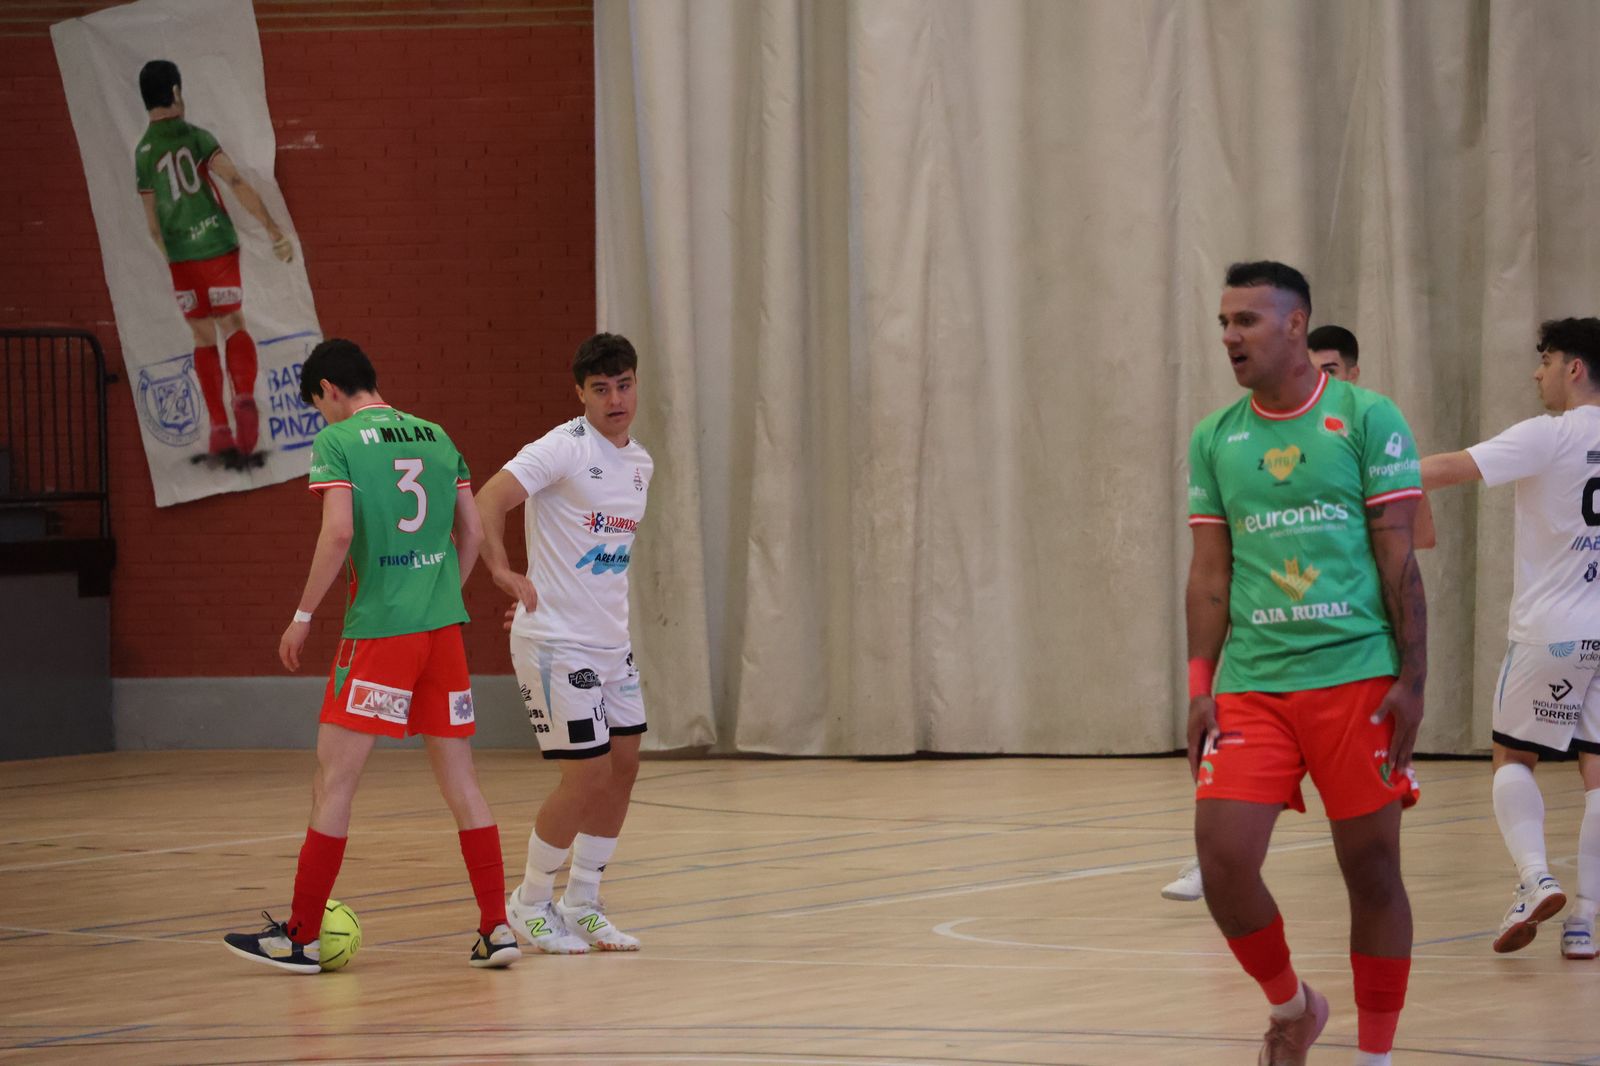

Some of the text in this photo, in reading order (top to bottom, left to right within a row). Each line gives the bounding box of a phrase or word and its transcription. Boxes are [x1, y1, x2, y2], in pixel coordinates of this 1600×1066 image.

[157, 146, 200, 201] 10
[380, 426, 437, 443] MILAR
[394, 458, 427, 533] 3
[1244, 499, 1349, 533] euronics
[1291, 602, 1353, 621] RURAL
[1533, 699, 1582, 711] INDUSTRIAS
[1534, 707, 1582, 720] TORRES
